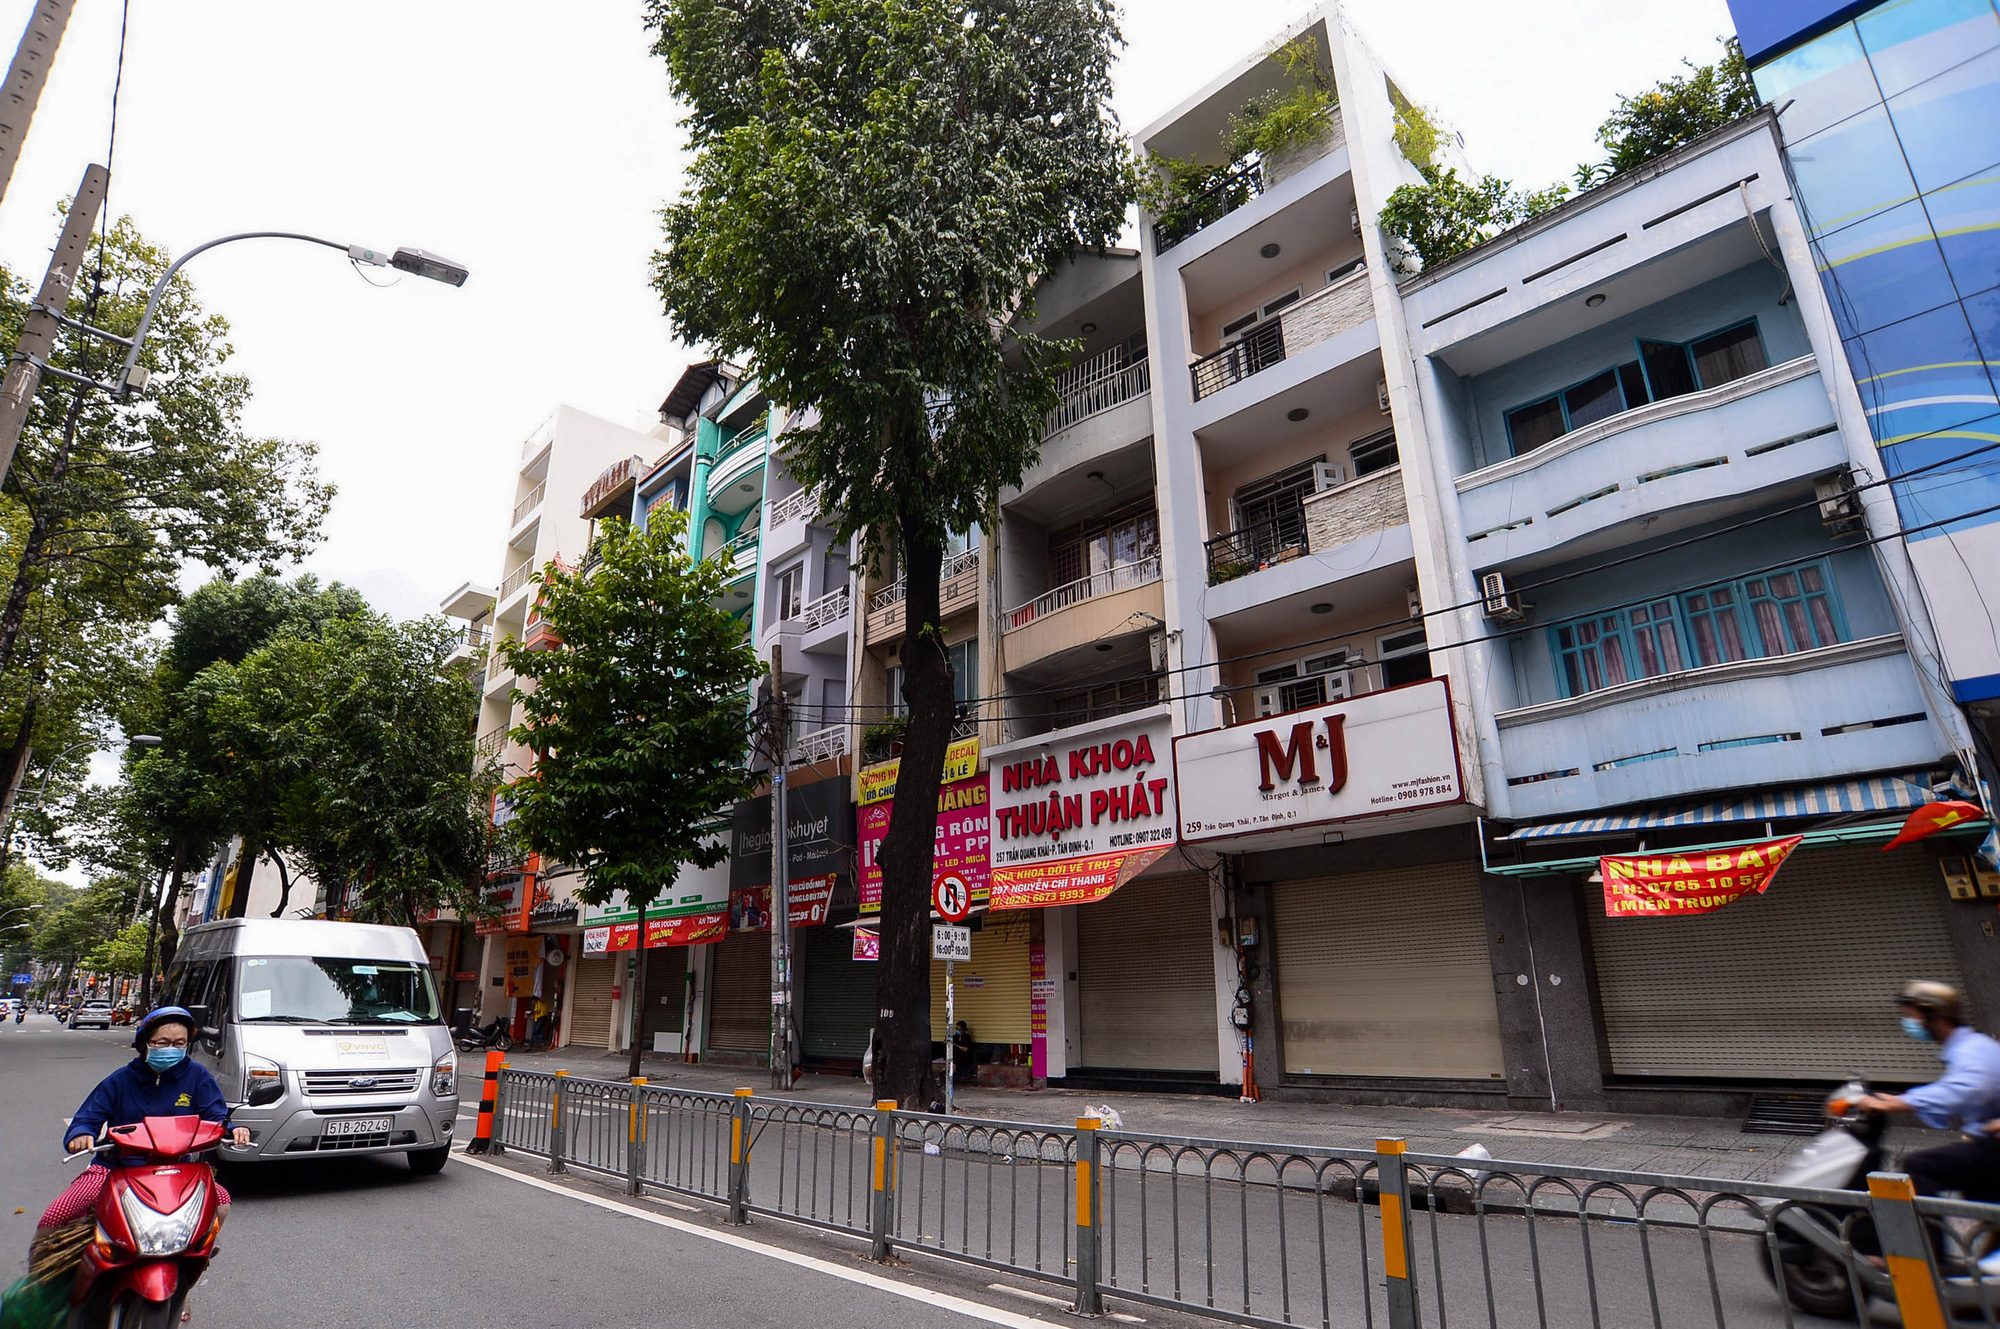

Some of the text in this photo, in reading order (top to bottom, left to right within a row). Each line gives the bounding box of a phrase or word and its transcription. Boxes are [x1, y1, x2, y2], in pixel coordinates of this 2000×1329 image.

[949, 744, 976, 761] DECAL
[1068, 734, 1155, 780] KHOA
[888, 768, 897, 780] IN
[950, 767, 955, 778] &
[1392, 774, 1451, 790] www.mjfashion.vn
[1261, 784, 1326, 802] Margot & James
[1397, 789, 1418, 801] 0908
[1420, 786, 1434, 797] 978
[1436, 783, 1452, 794] 884
[995, 771, 1168, 841] THUẬN PHÁT
[949, 816, 989, 837] RÔN
[1186, 821, 1202, 833] 259
[1218, 820, 1235, 830] Quang
[1287, 811, 1297, 819] Q.1
[965, 835, 989, 852] PP
[1109, 827, 1172, 847] HOTLINE: 0907 322 499
[945, 858, 959, 867] LED
[965, 854, 986, 864] MICA
[996, 851, 1005, 863] 257
[1020, 847, 1037, 860] QUANG
[1058, 841, 1068, 854] TÂN
[1016, 868, 1045, 880] KHOA
[1047, 864, 1067, 876] DỜI
[1069, 859, 1083, 873] VỀ
[1088, 859, 1110, 872] TRỤ
[1608, 854, 1694, 880] NHÀ
[1011, 878, 1049, 893] NGUYỄN
[1051, 876, 1069, 890] CHÍ
[1071, 873, 1106, 887] THANH
[1612, 883, 1643, 895] LH:
[1648, 879, 1700, 894] 0785
[1706, 876, 1733, 889] 10
[1005, 894, 1030, 905] (028)
[1032, 892, 1057, 902] 6673
[1059, 889, 1085, 901] 9393
[1613, 896, 1671, 912] (MIỄN
[661, 919, 682, 928] VOUCHER
[880, 1009, 894, 1018] 109
